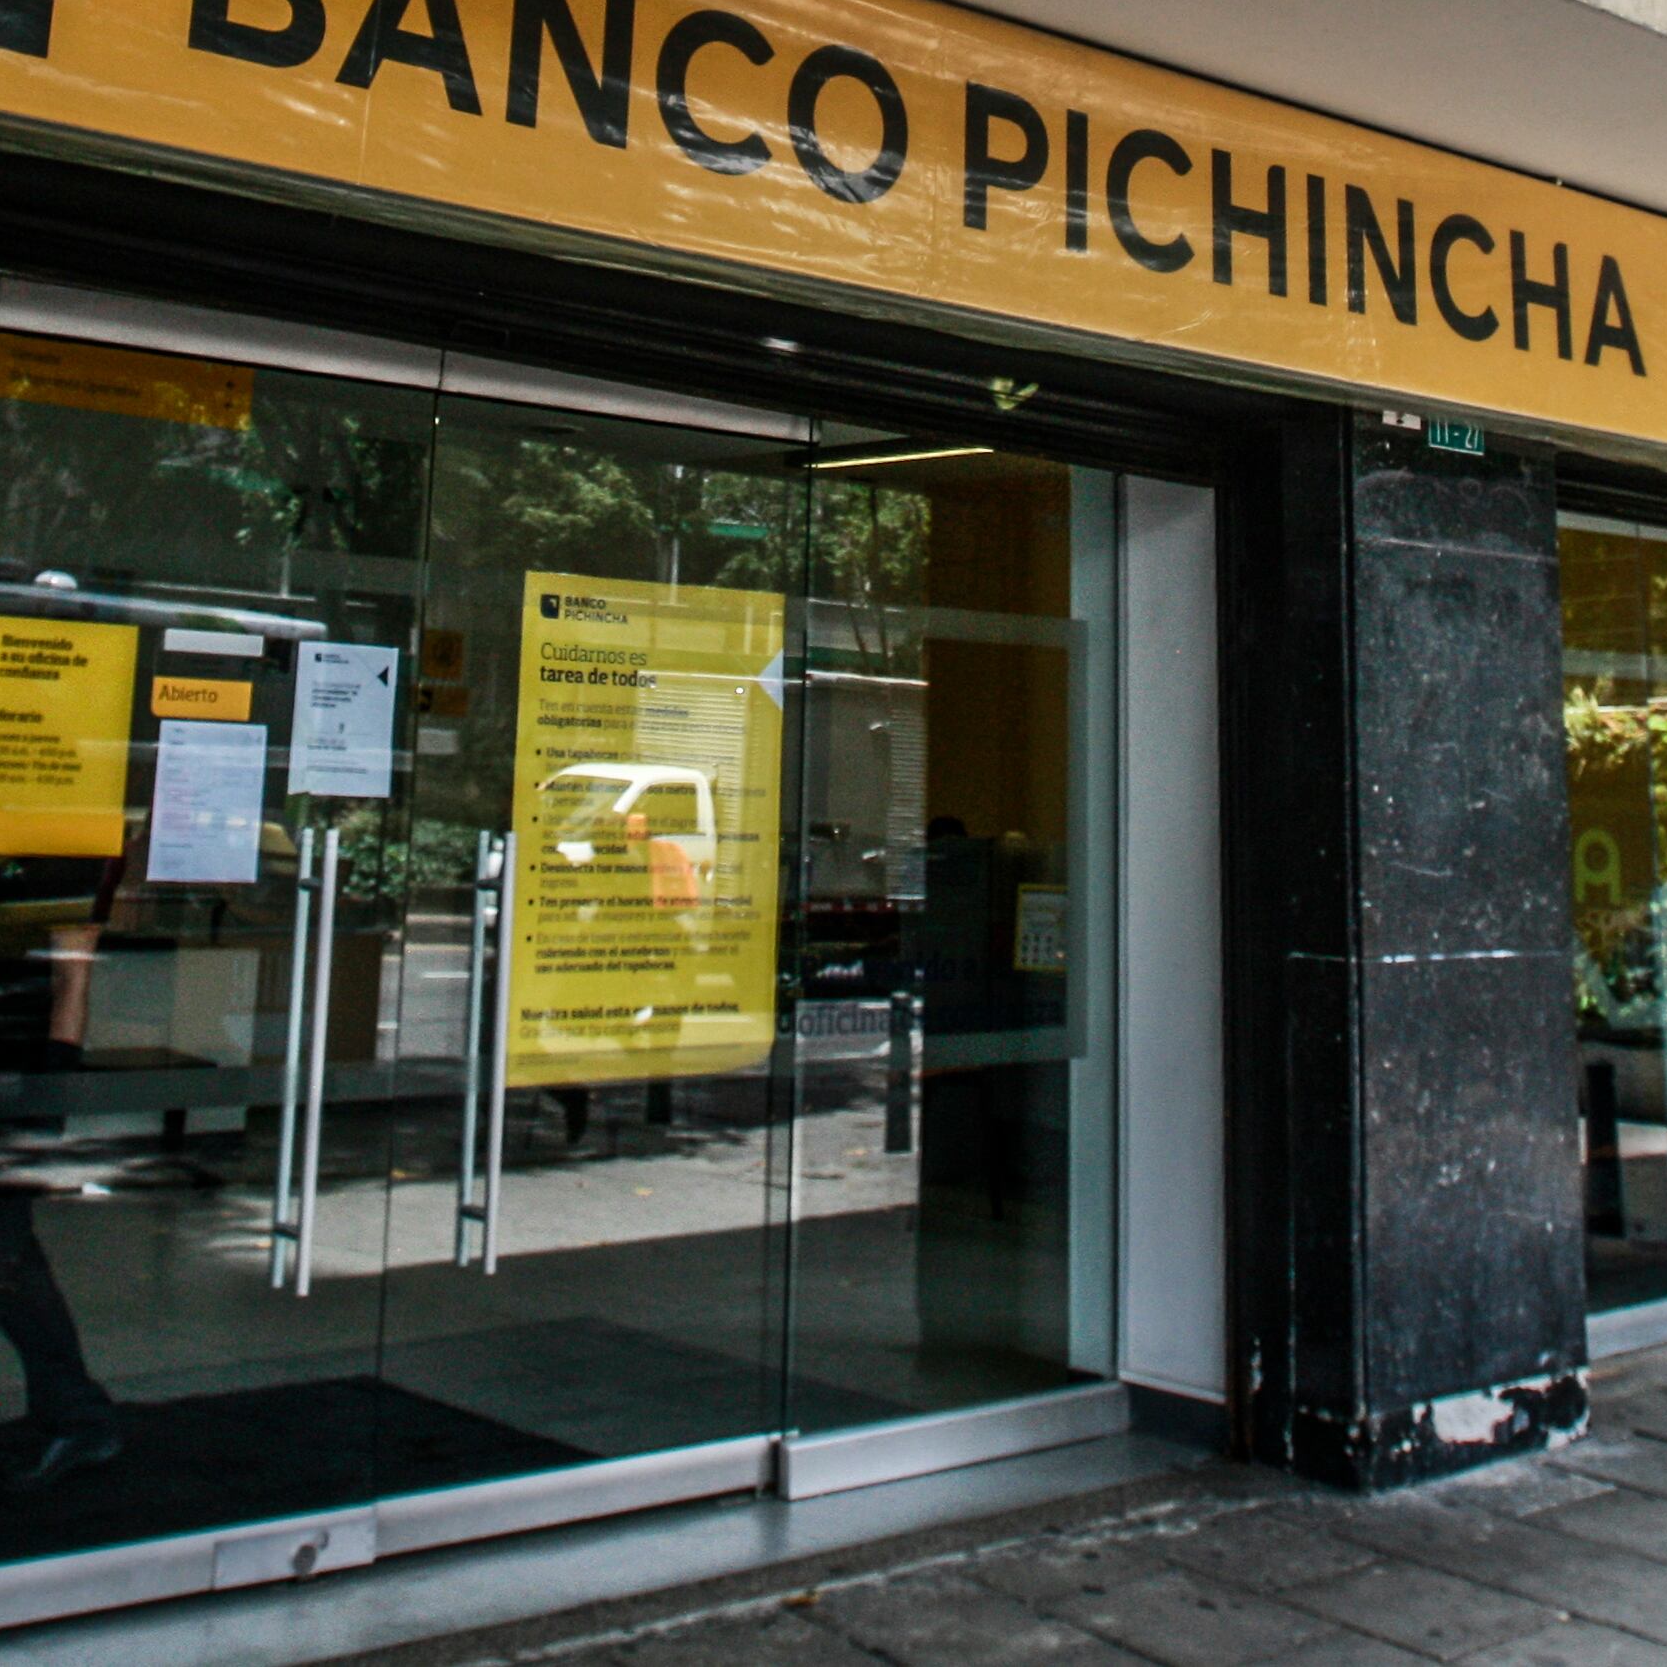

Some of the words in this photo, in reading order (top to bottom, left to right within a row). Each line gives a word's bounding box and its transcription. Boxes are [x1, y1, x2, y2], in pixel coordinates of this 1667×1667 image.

[962, 79, 1647, 378] PICHINCHA
[564, 596, 607, 610] BANCO
[564, 610, 628, 624] PICHINCHA
[540, 642, 625, 665] Cuidarnos
[629, 649, 647, 666] es
[540, 666, 584, 684] tarea
[587, 667, 607, 685] de
[158, 685, 219, 704] Abierto
[537, 713, 602, 729] obligatorias
